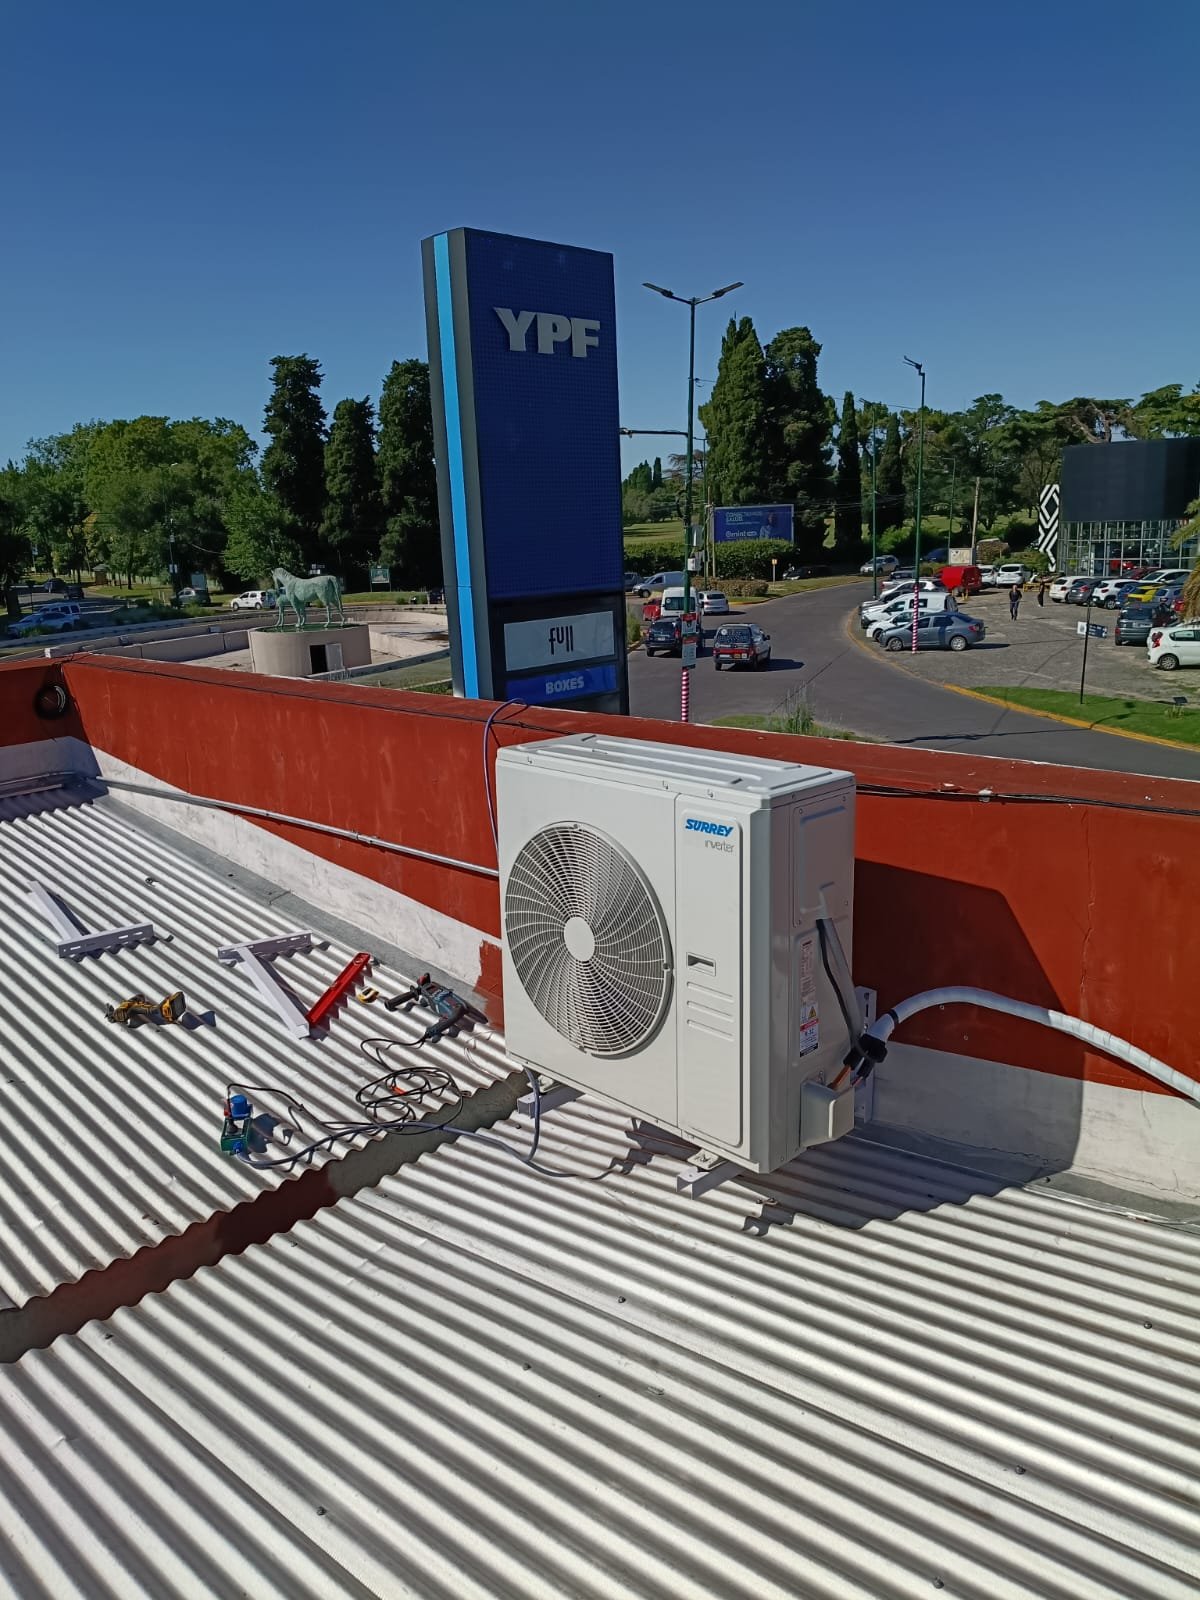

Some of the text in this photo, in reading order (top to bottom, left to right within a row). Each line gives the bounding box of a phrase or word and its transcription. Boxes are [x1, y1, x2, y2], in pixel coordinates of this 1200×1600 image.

[493, 307, 600, 357] YPF
[549, 626, 574, 655] full
[546, 677, 585, 695] BOXES
[686, 819, 734, 837] SURREY
[706, 840, 735, 853] inverter
